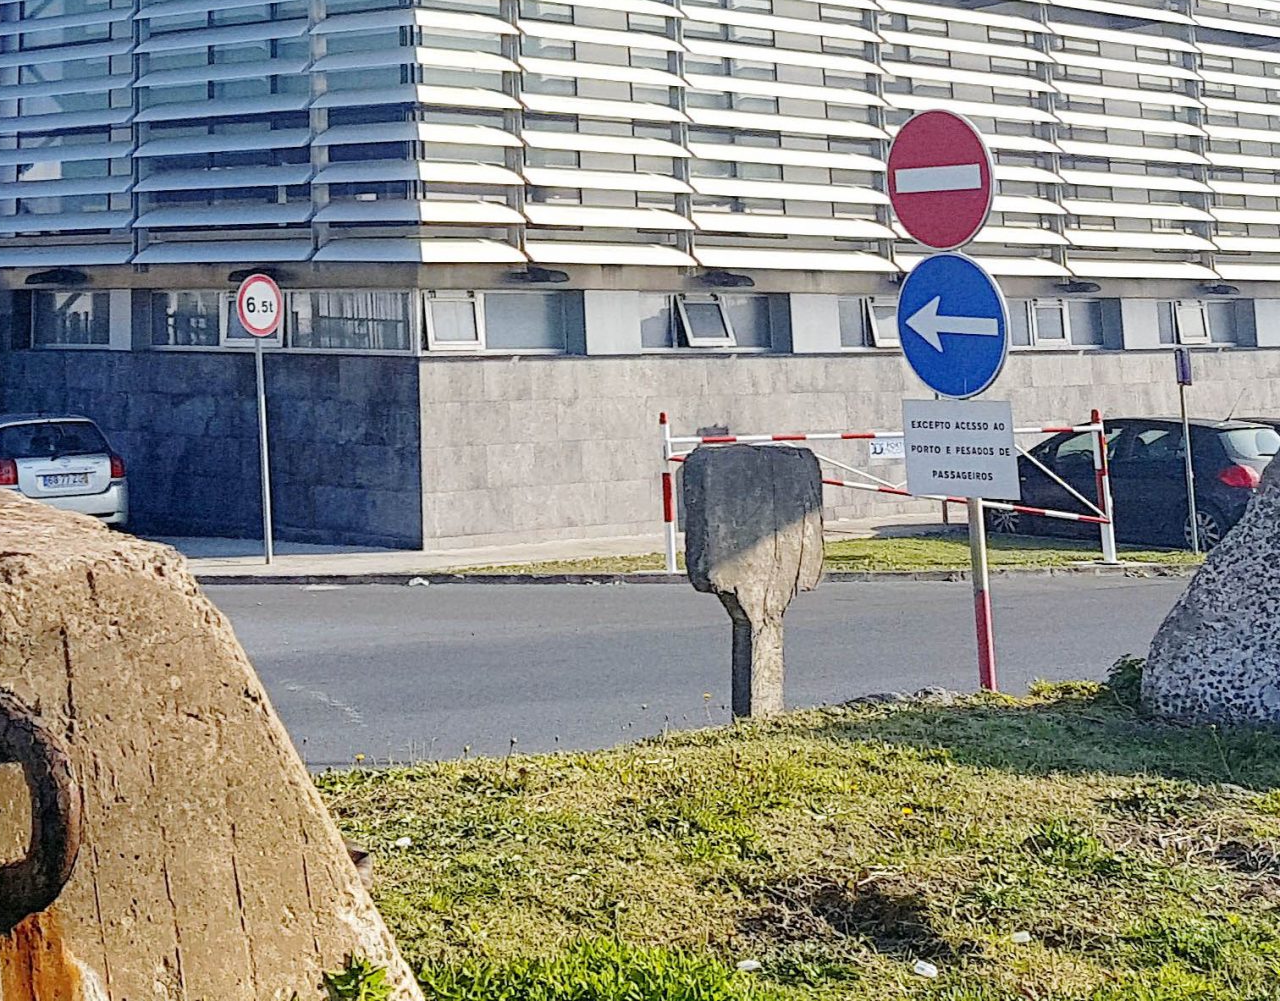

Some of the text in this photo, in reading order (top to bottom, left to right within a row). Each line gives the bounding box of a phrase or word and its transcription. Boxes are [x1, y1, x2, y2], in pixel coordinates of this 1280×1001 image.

[246, 296, 274, 313] 6.5t
[910, 420, 1005, 431] EXCEPTO ACESSO AO
[910, 445, 941, 454] PORTO
[946, 446, 952, 454] E
[955, 446, 994, 456] PESADOS
[999, 447, 1011, 457] DE
[932, 470, 994, 481] PASSAGEIROS
